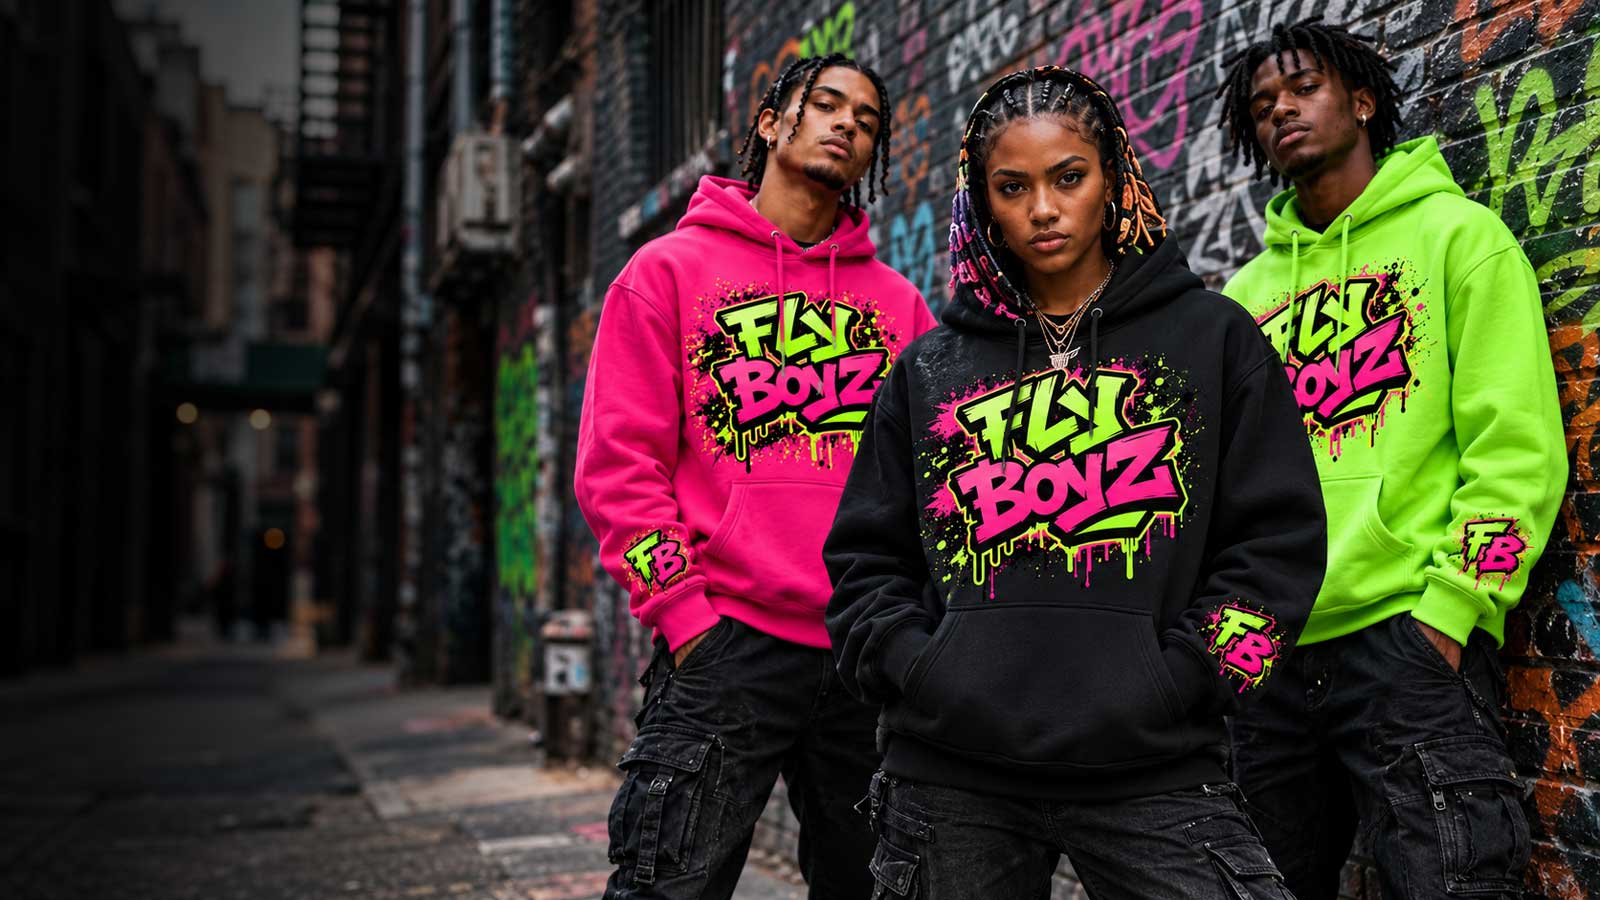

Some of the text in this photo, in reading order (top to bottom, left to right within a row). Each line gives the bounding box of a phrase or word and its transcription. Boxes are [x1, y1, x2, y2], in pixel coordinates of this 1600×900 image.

[718, 295, 854, 365] FLY
[1283, 313, 1409, 419] OYZ
[962, 373, 1131, 461] FLY
[953, 424, 1180, 546] BOYZ
[624, 530, 685, 584] FB
[1465, 520, 1525, 572] FB
[1214, 606, 1275, 676] FB
